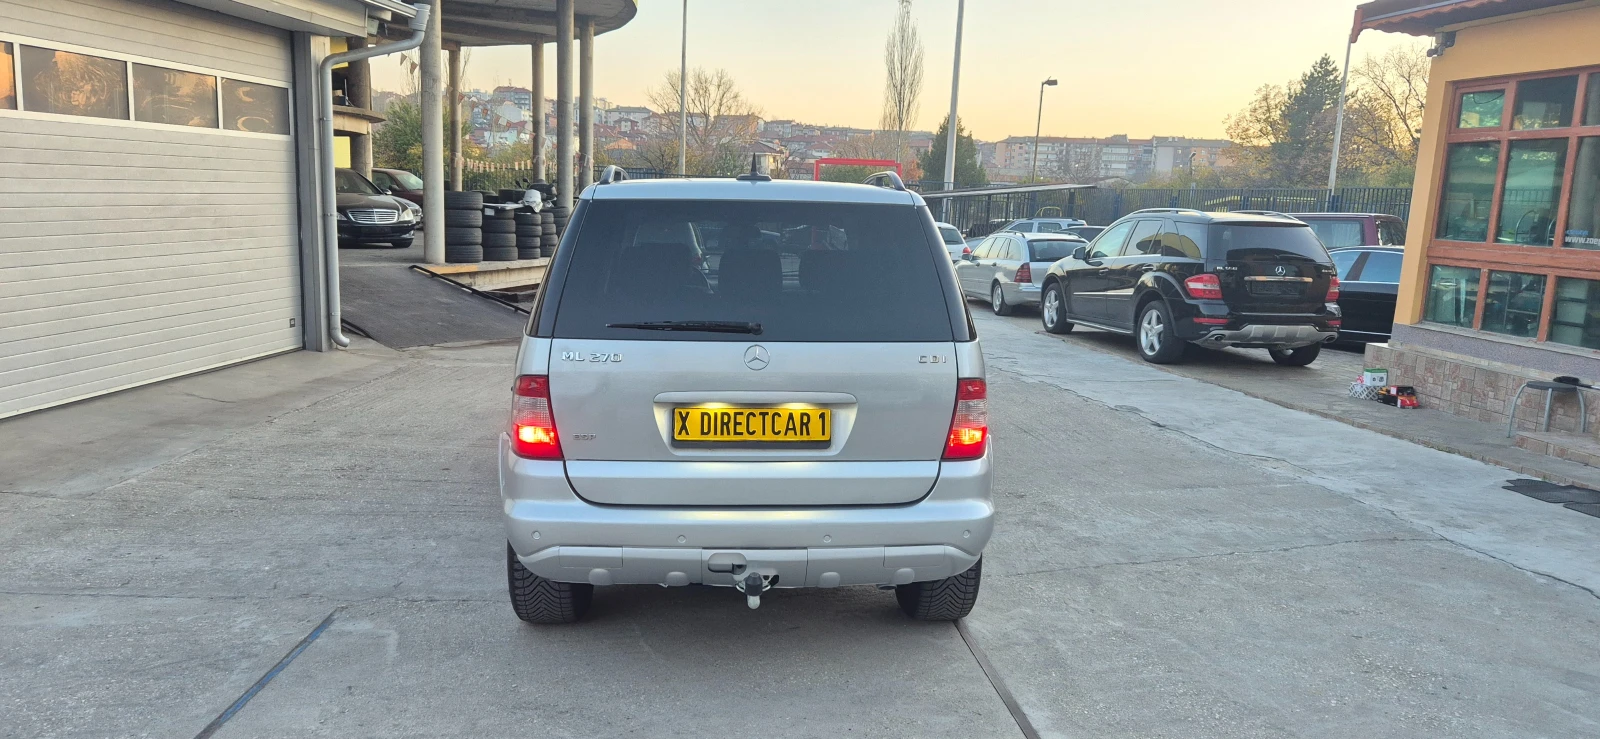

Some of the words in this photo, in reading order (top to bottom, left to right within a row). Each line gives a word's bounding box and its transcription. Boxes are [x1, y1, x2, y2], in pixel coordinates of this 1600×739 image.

[561, 351, 585, 361] ML
[589, 352, 622, 362] 270
[918, 355, 947, 364] CDI
[677, 411, 690, 436] X
[700, 411, 811, 437] DIRECTCAR
[818, 411, 826, 436] 1
